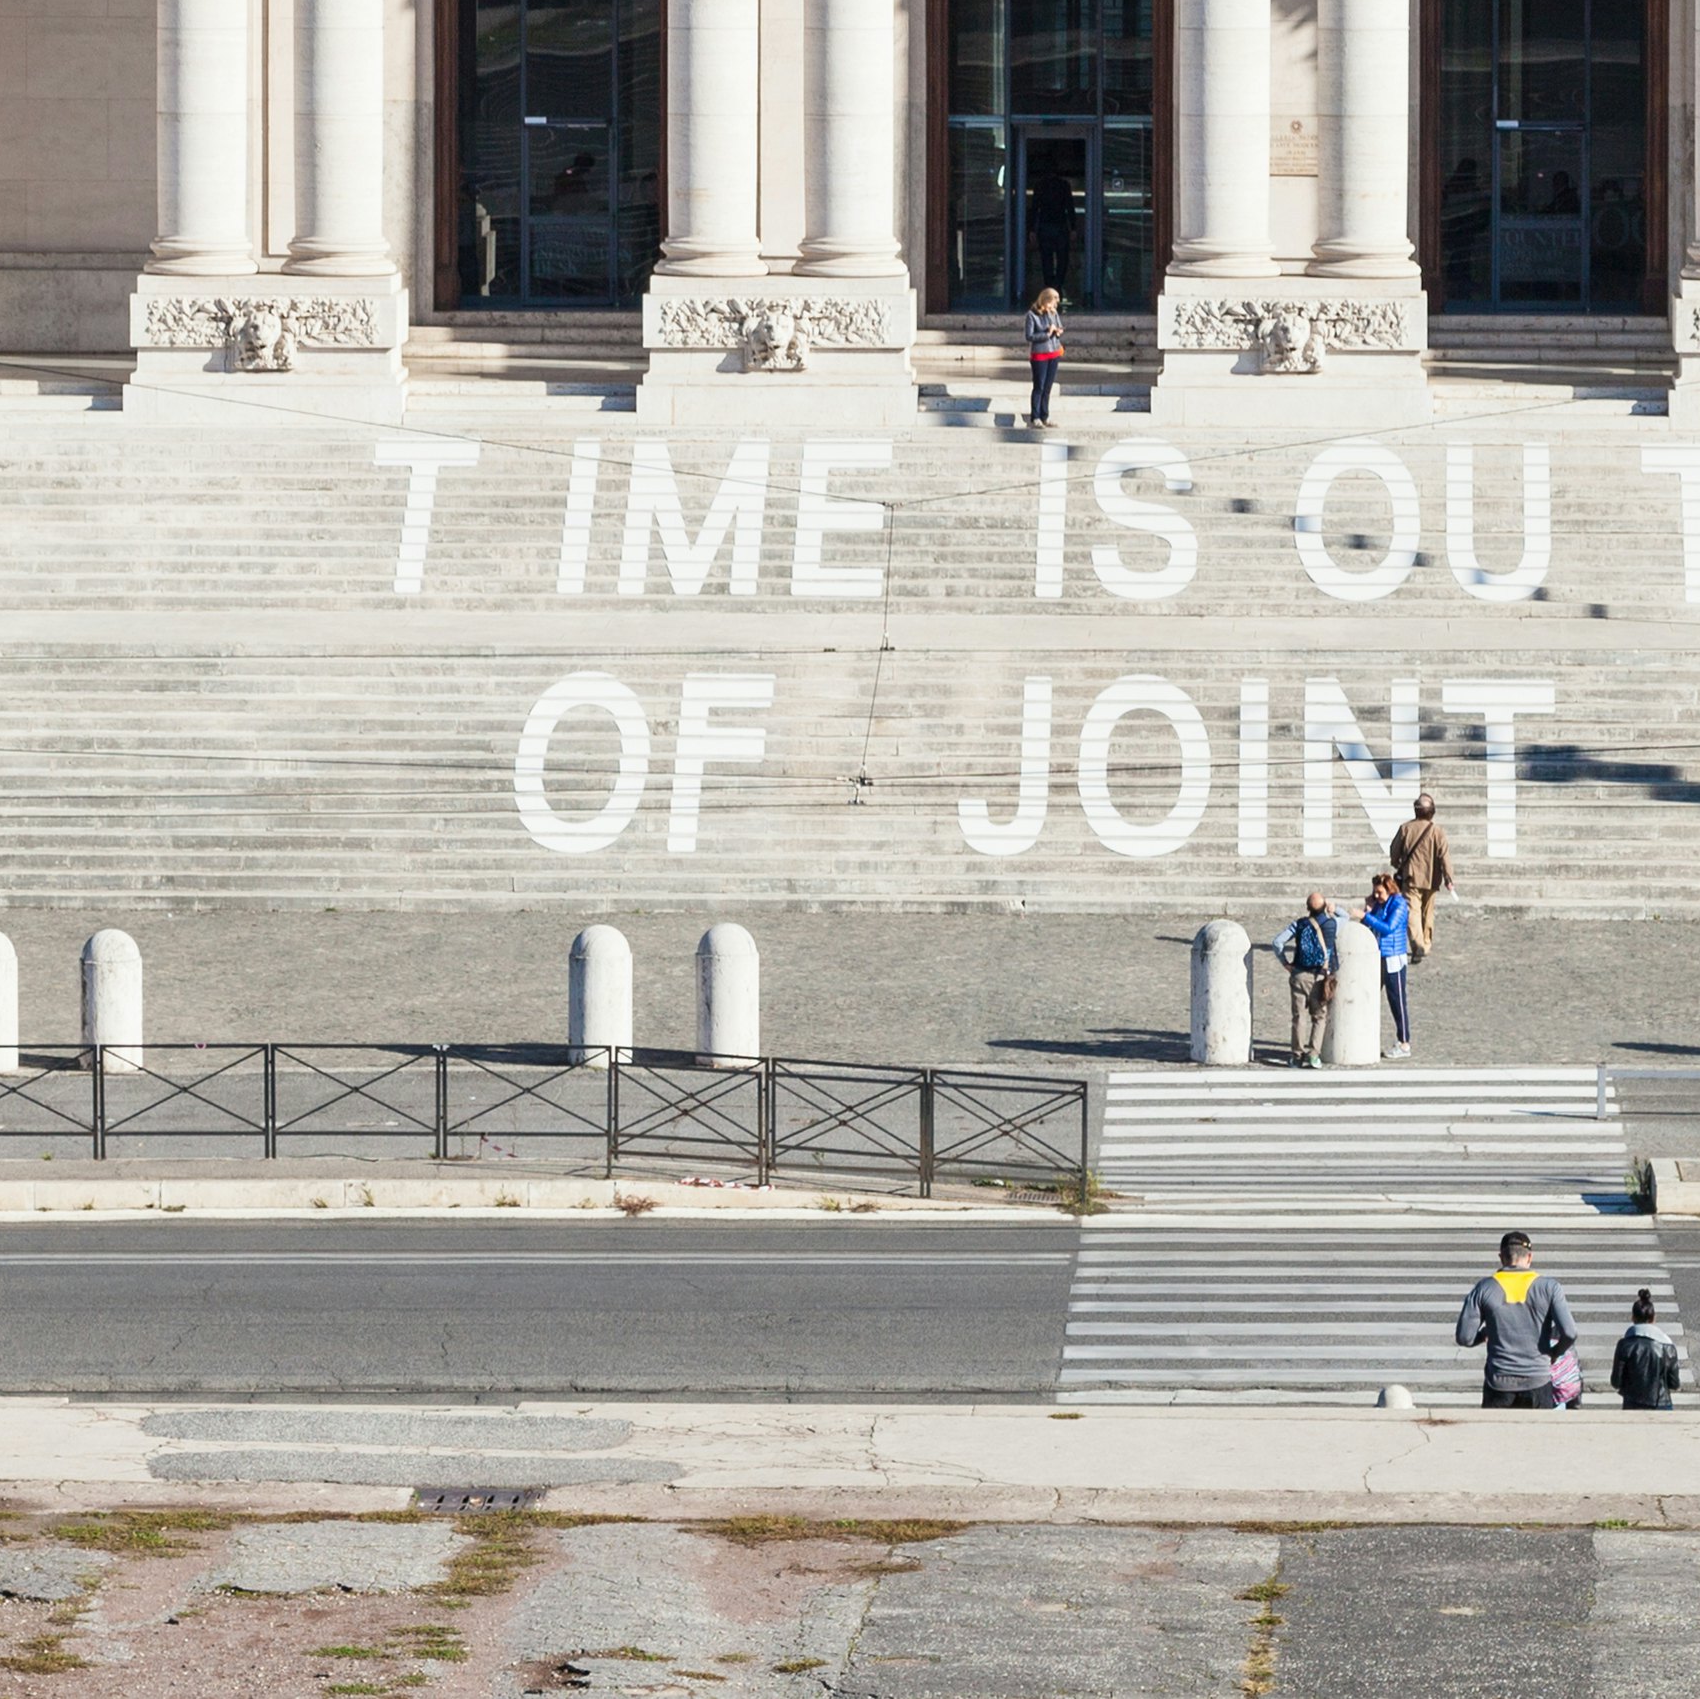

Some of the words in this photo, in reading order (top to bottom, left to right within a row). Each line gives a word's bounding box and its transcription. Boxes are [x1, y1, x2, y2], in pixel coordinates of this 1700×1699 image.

[372, 440, 893, 595] TIME
[1034, 440, 1198, 600] IS
[513, 672, 775, 854] OF
[958, 676, 1556, 858] JOINT
